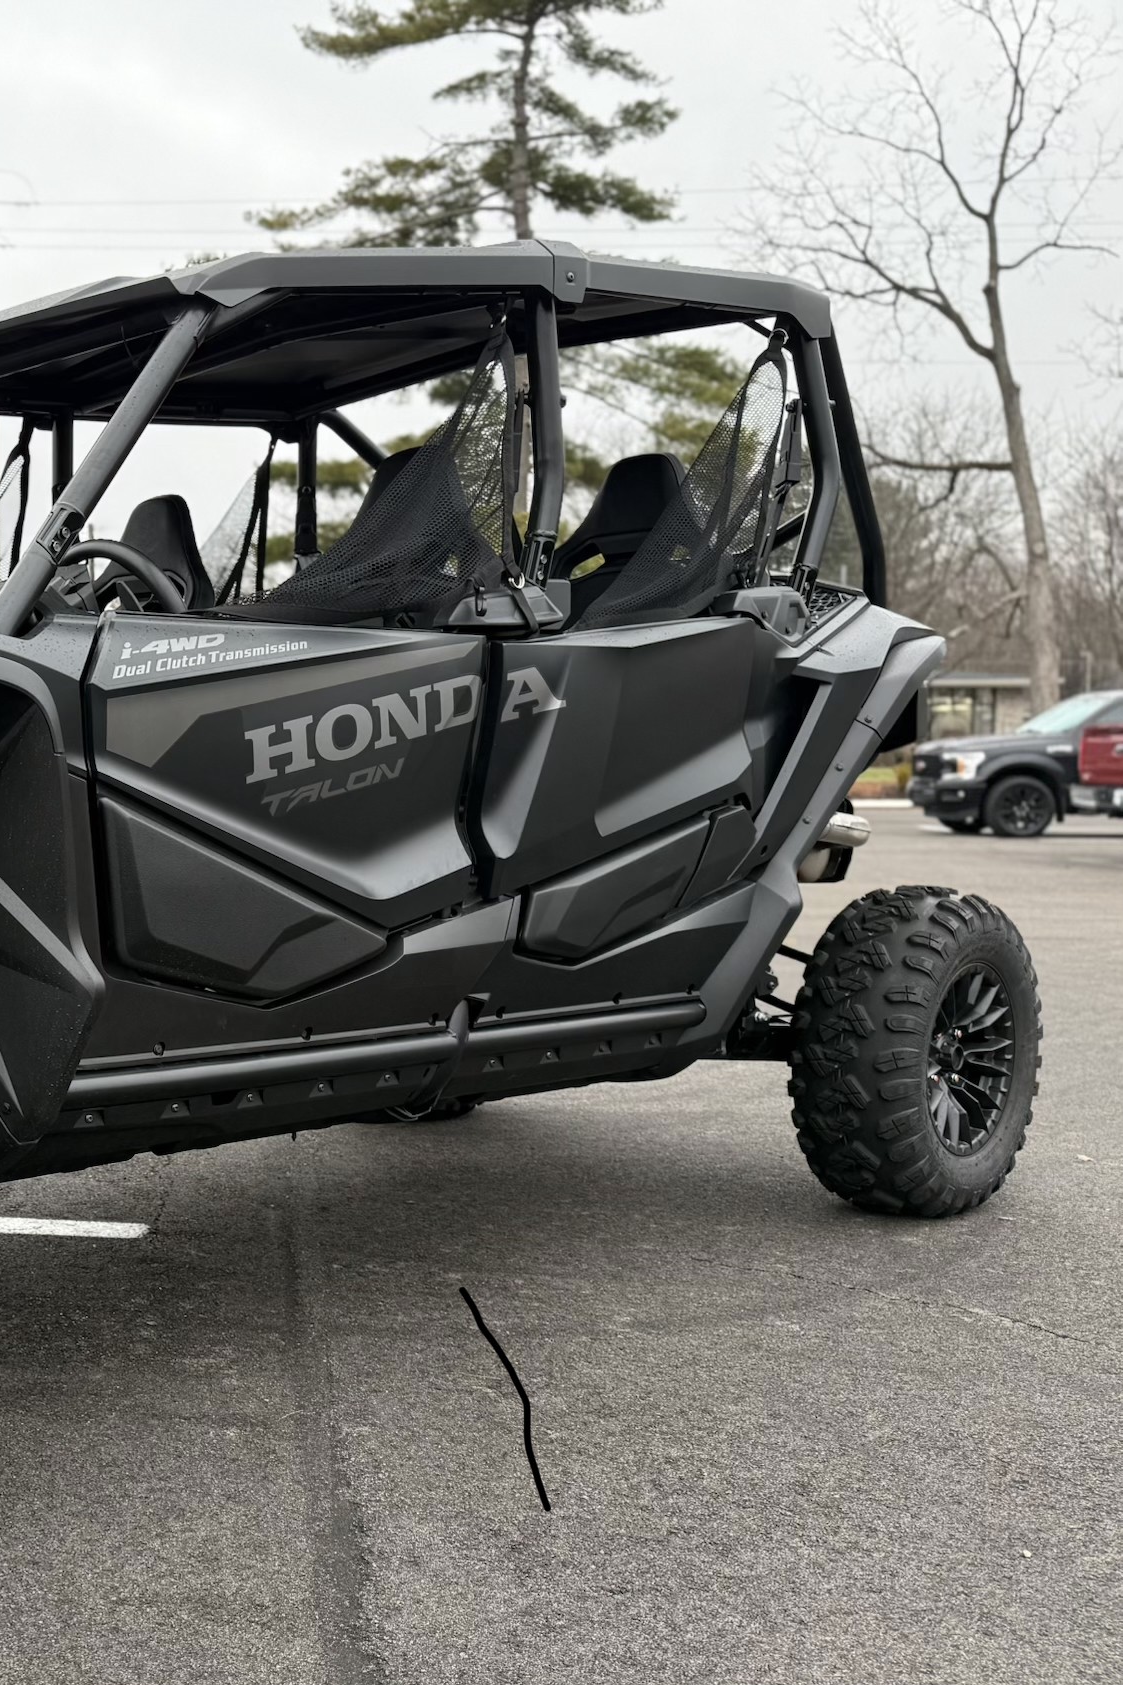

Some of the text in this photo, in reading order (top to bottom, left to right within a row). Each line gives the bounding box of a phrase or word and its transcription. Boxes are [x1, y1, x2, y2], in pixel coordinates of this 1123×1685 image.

[112, 640, 308, 679] Dual Clutch Transmission
[120, 633, 225, 660] i-4WD
[244, 666, 567, 785] HONDA
[261, 757, 405, 817] TALON
